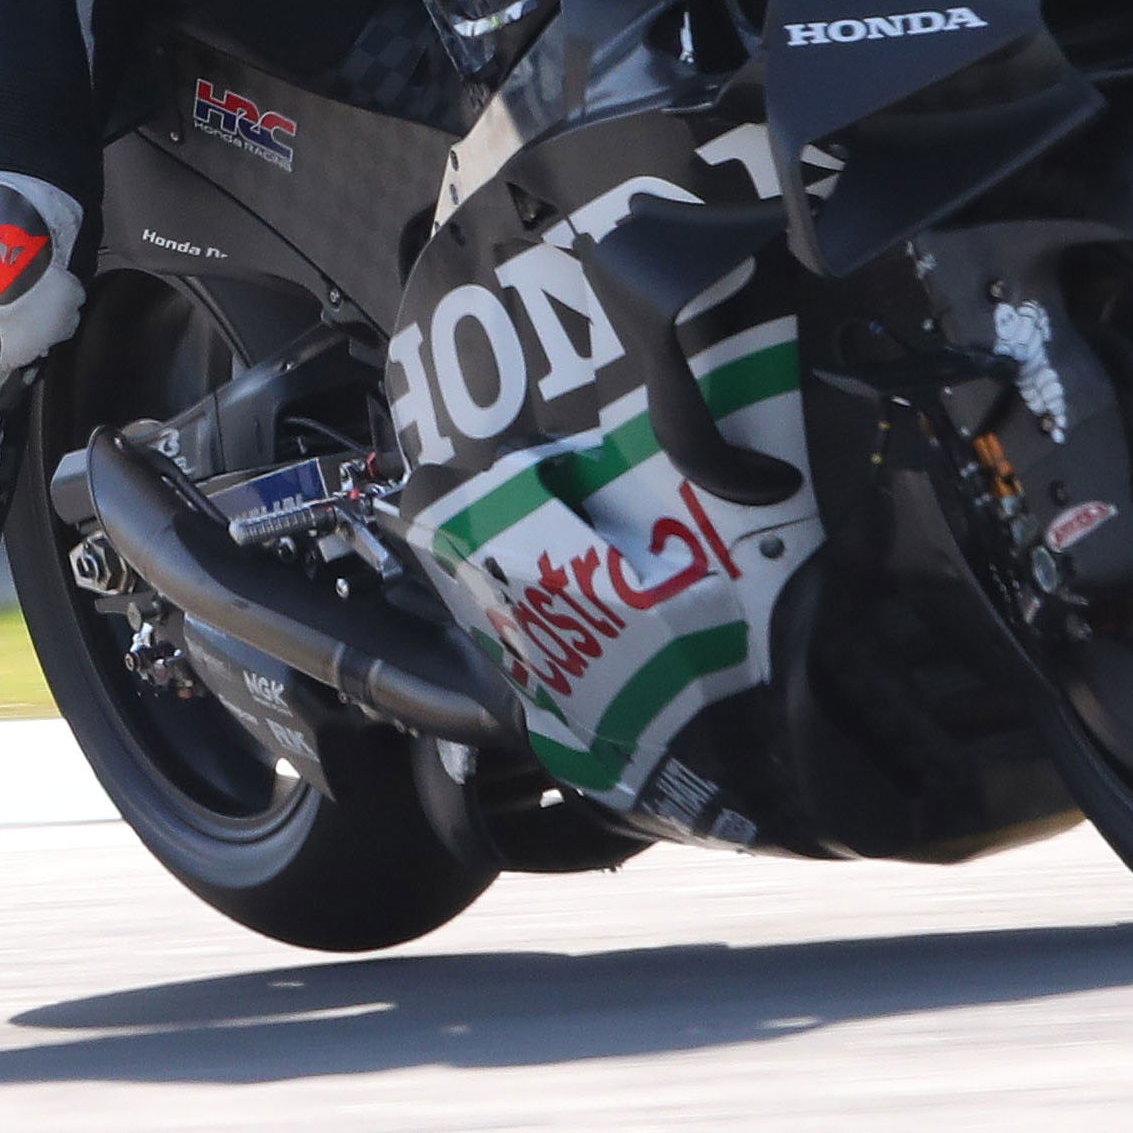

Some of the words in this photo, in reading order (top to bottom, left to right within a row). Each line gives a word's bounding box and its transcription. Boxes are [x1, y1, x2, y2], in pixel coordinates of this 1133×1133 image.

[785, 6, 988, 48] HONDA
[193, 78, 297, 163] HRC
[142, 229, 201, 256] Honda
